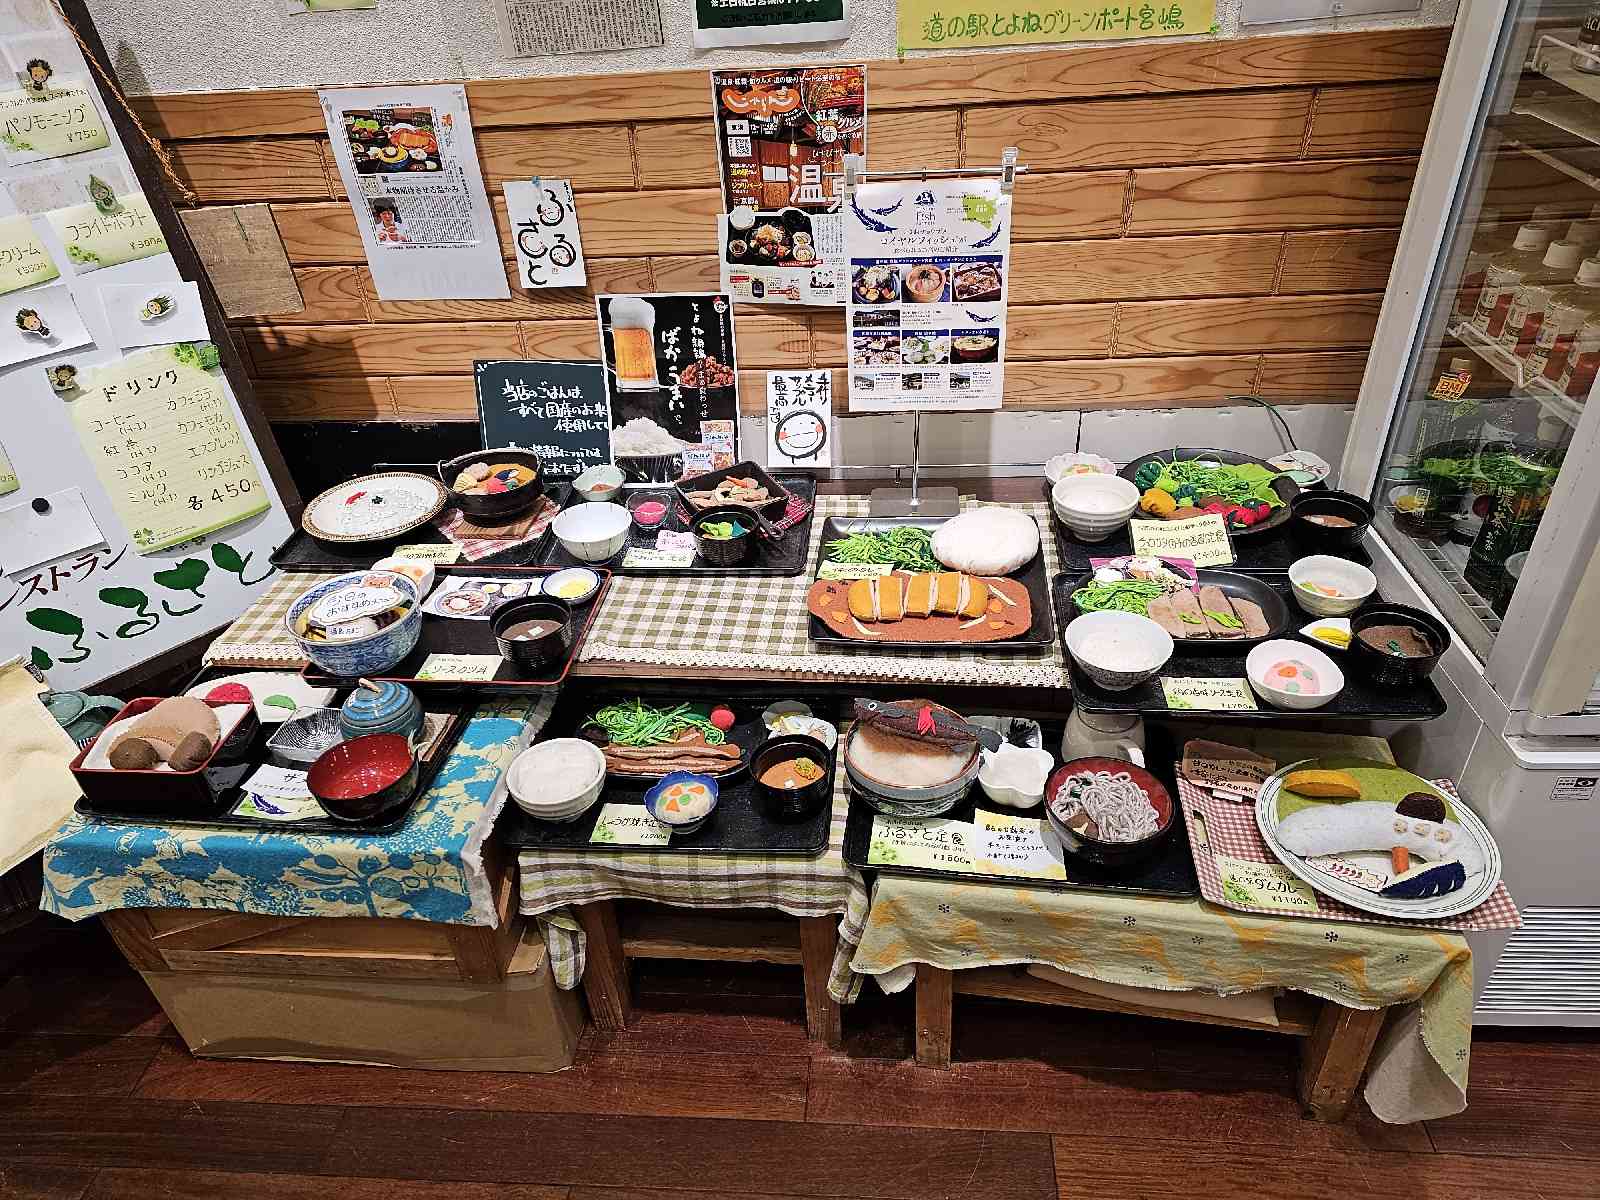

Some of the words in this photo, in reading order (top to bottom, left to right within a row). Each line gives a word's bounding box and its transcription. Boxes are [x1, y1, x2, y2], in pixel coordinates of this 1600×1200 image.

[921, 4, 1184, 41] 道の駅とよねグリーンポート宮嶋
[5, 103, 87, 136] パンモーニング
[0, 242, 41, 264] クリーム
[103, 369, 178, 402] ドリンク
